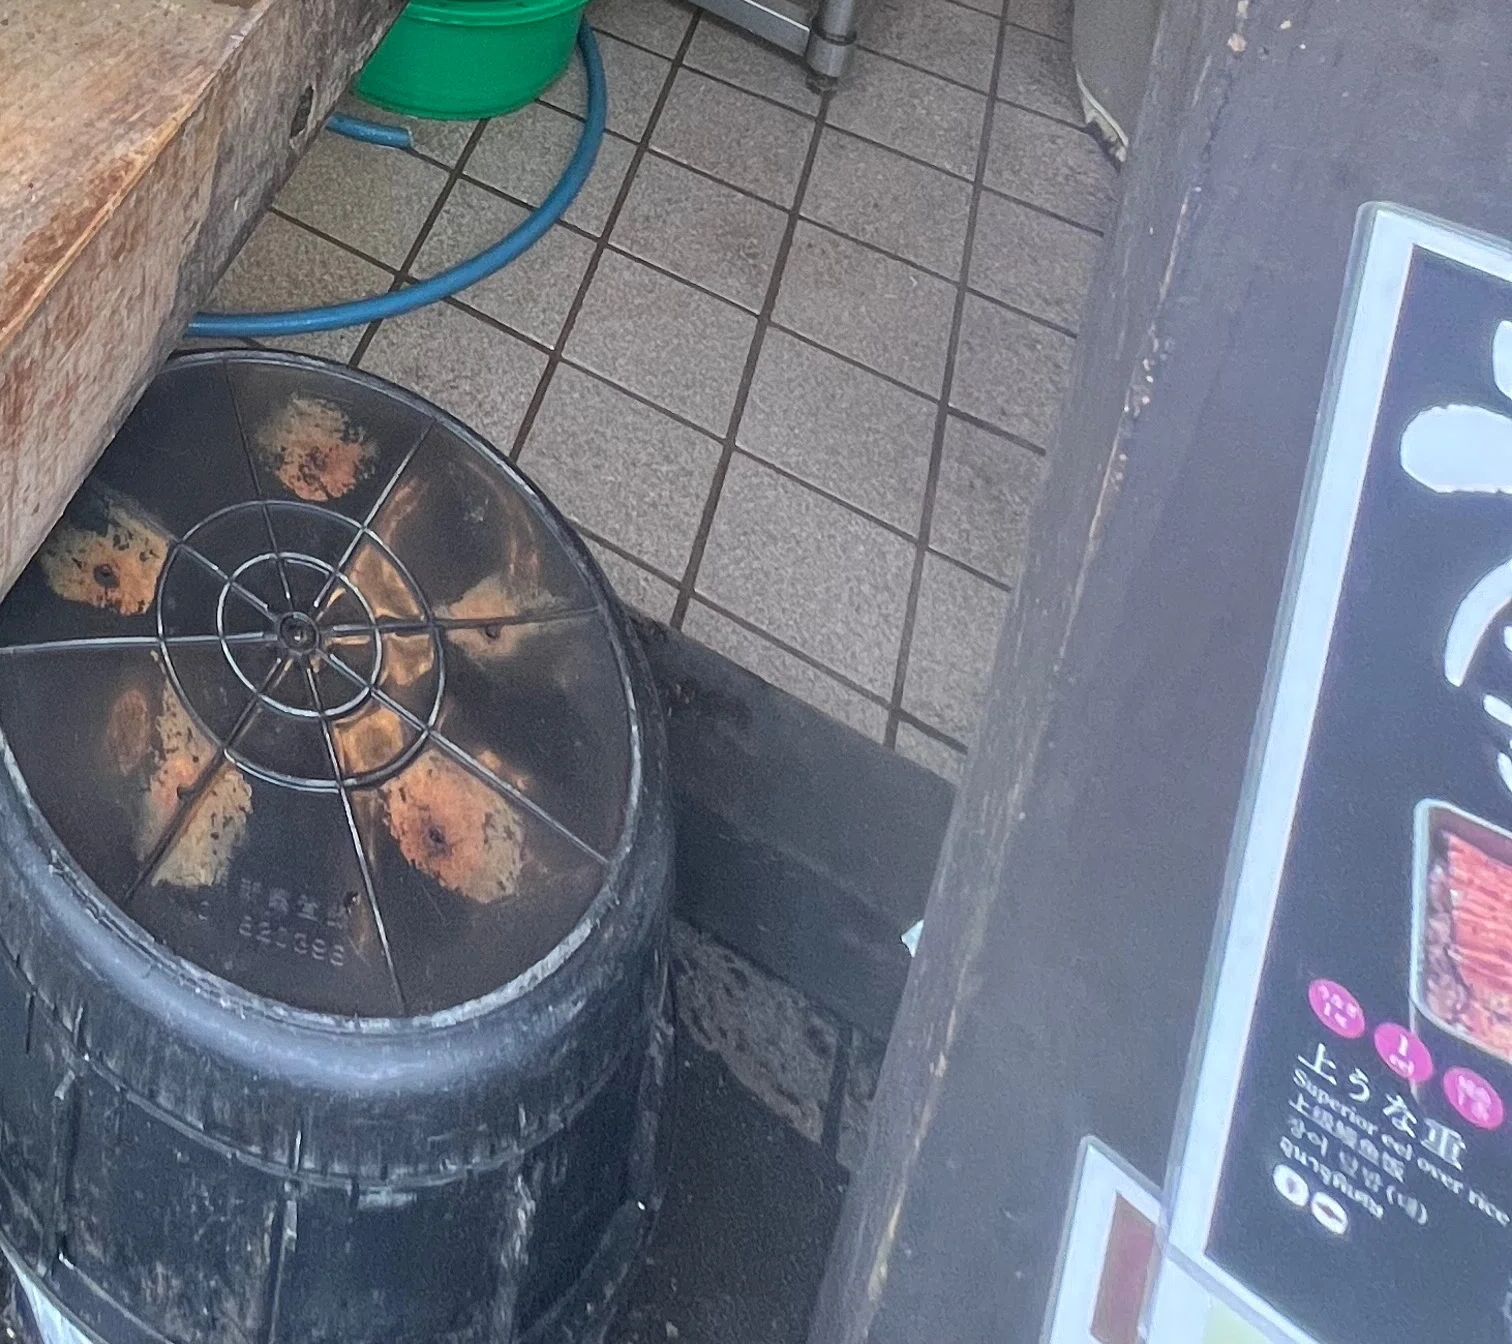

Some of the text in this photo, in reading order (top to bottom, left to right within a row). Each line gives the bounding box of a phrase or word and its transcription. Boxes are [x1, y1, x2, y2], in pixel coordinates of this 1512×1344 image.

[1292, 1068, 1379, 1136] Superior
[1380, 1133, 1413, 1162] eel
[1417, 1156, 1464, 1194] over
[1468, 1187, 1511, 1227] rice
[1297, 1042, 1467, 1172] 上うな重
